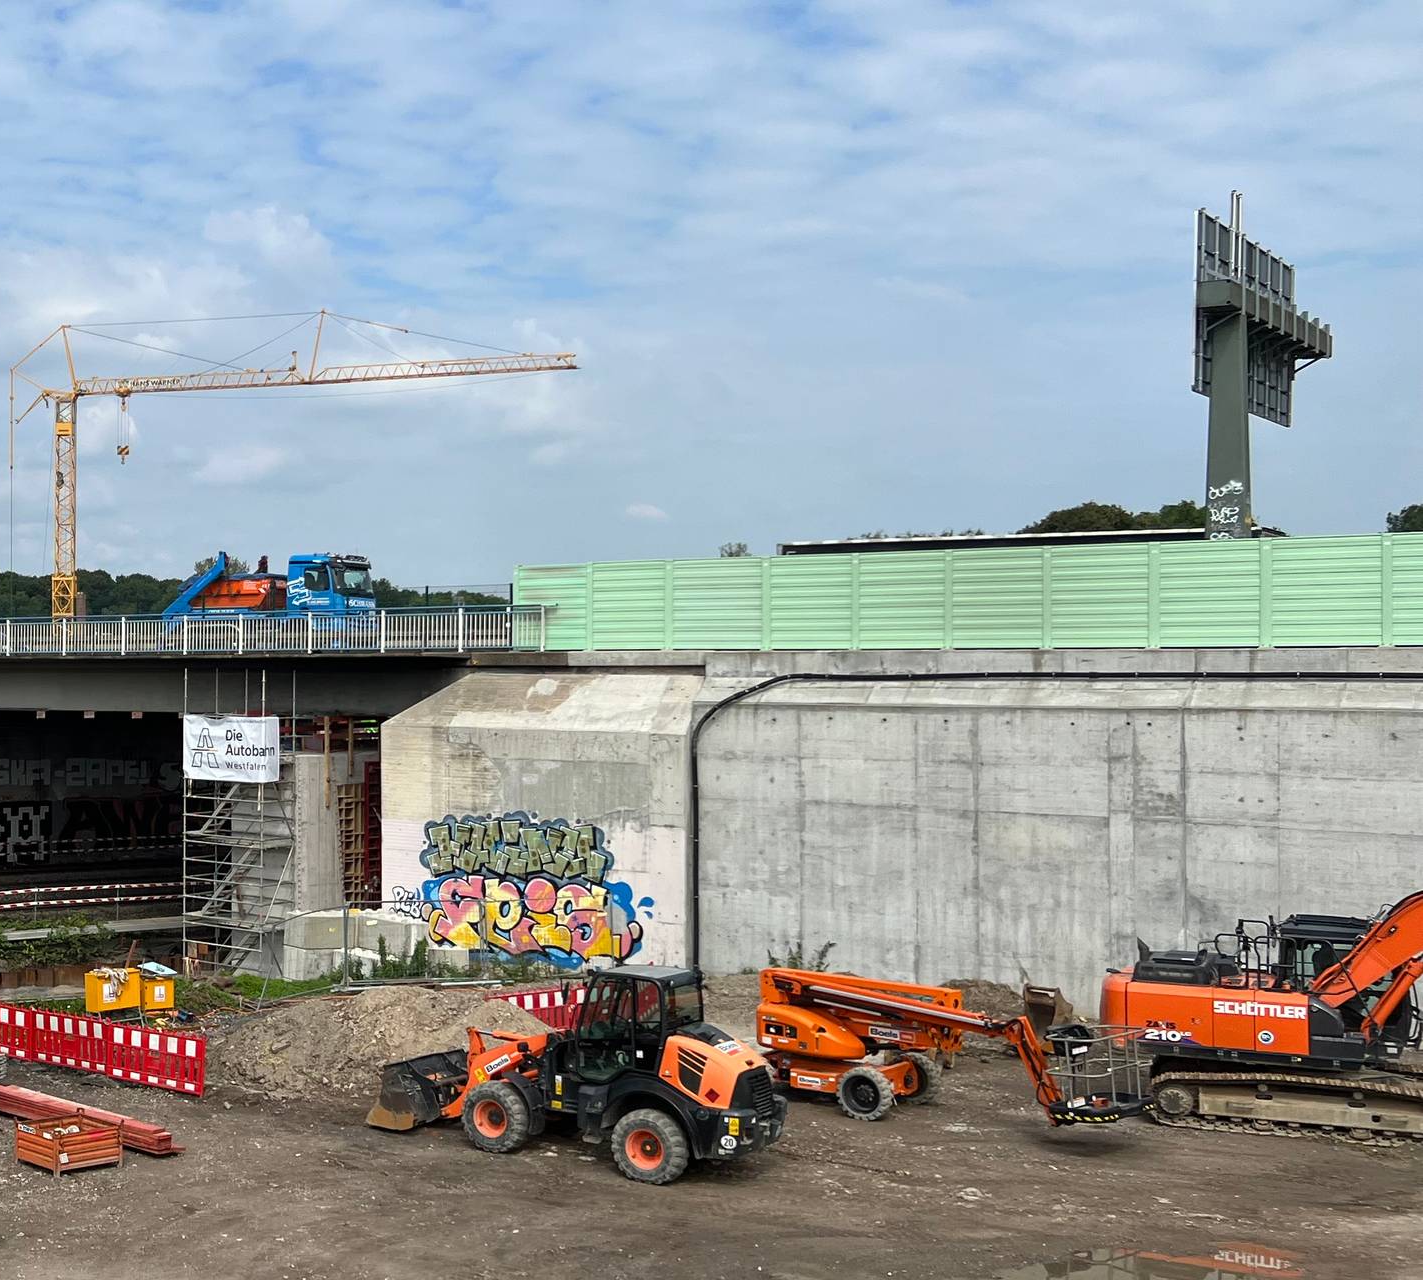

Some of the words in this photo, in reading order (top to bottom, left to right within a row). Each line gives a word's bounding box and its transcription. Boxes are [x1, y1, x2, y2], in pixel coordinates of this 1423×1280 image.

[225, 728, 243, 742] Die
[225, 744, 275, 757] Autobahn
[225, 762, 267, 771] Westfalen
[1213, 1000, 1306, 1019] SCHÖTTLER
[1146, 1020, 1176, 1029] ZAXIS
[870, 1027, 899, 1039] Boels
[1145, 1028, 1181, 1042] 210
[485, 1056, 510, 1073] Boels
[724, 1137, 734, 1148] 20
